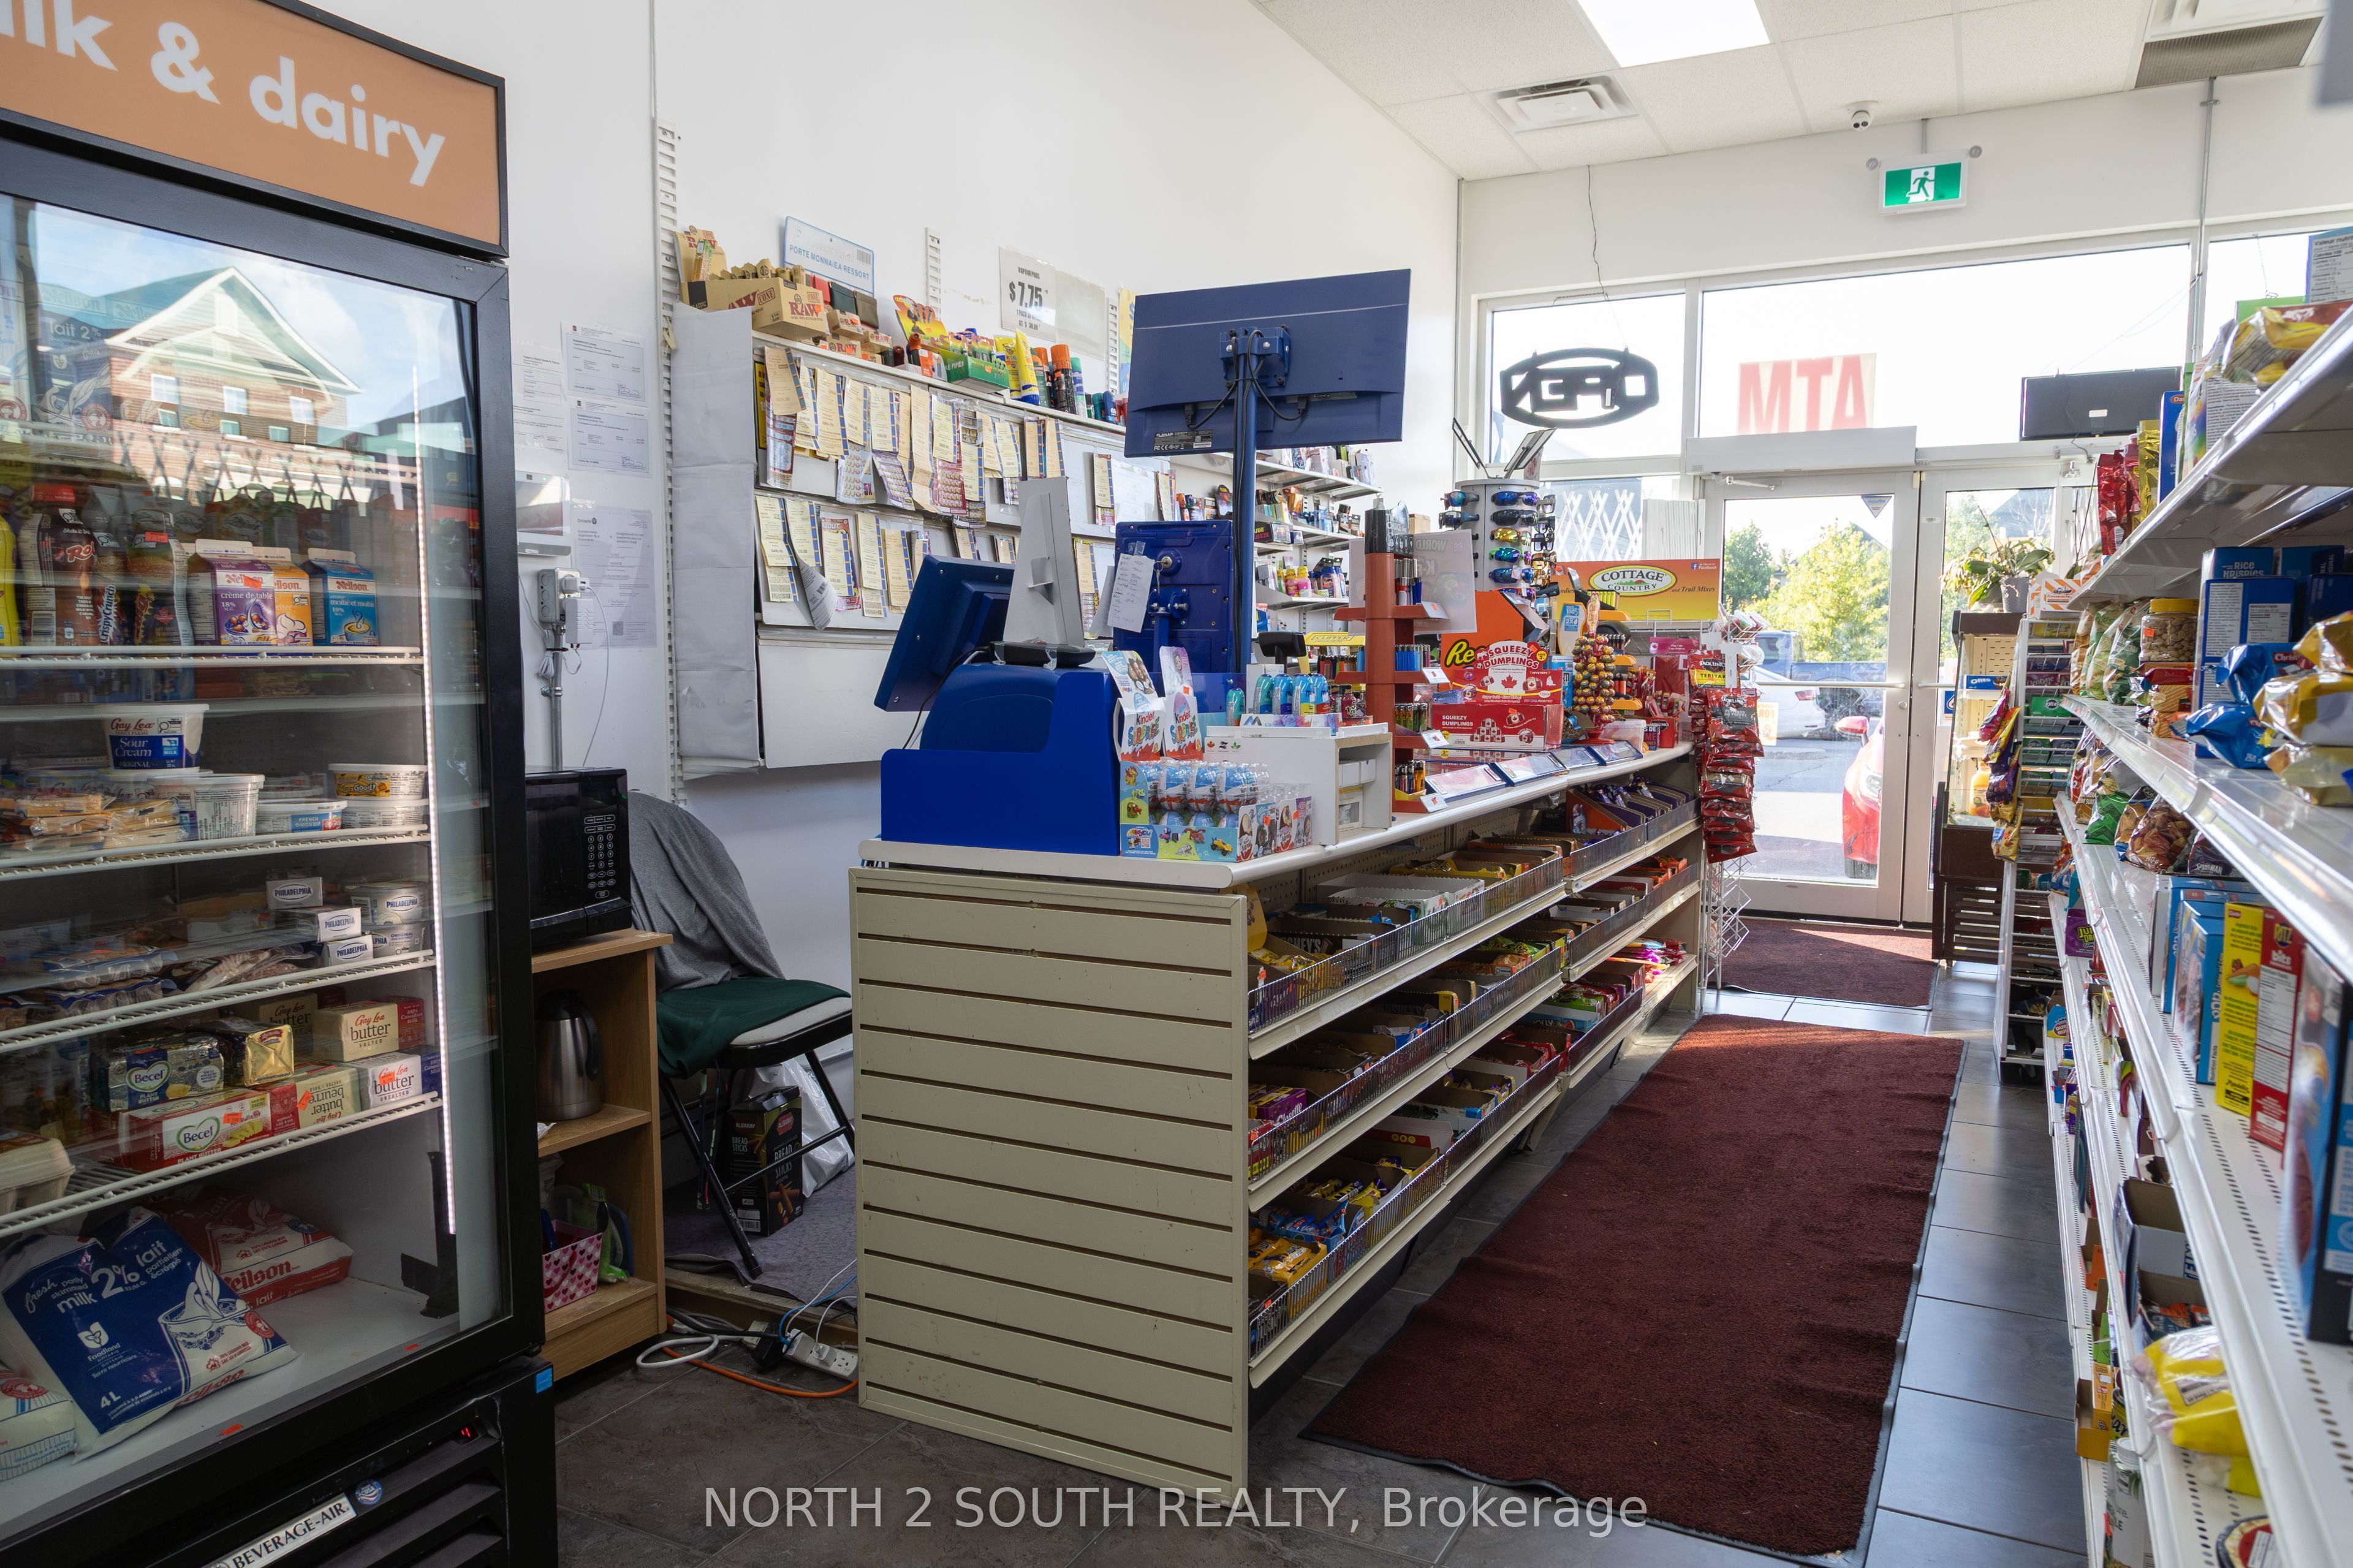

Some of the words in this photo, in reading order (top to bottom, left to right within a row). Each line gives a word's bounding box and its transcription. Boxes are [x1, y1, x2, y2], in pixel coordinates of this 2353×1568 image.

[150, 21, 222, 105] &
[248, 55, 446, 187] dairy
[686, 235, 718, 249] RW
[789, 244, 809, 259] PORTE
[843, 265, 870, 280] RESSORT
[728, 290, 759, 309] AW
[757, 287, 776, 305] CONE
[807, 292, 820, 302] CONE
[789, 301, 820, 318] RAW
[875, 334, 890, 343] RAW
[2234, 561, 2255, 570] Rice
[1601, 570, 1664, 583] COTTAGE
[336, 580, 369, 592] Neilson
[1607, 583, 1658, 592] COUNTRY
[1487, 645, 1534, 658] SQUEEZY
[1483, 656, 1540, 670] DUMPLINGS
[2027, 675, 2054, 687] Dentyne
[110, 717, 131, 732] Gay
[134, 718, 155, 730] Lea
[119, 738, 148, 749] Sour
[115, 747, 152, 757] Cream
[354, 784, 377, 793] Good!
[275, 887, 312, 897] PHILADELPHIA
[386, 897, 418, 909] PHILADELPHIA
[325, 917, 355, 929] PHILADELPHIA
[2275, 924, 2293, 944] RITZ
[336, 943, 368, 958] PHILADELPHIA
[2272, 950, 2292, 965] bits
[355, 1014, 371, 1026] Gay
[373, 1012, 386, 1023] Lea
[350, 1022, 391, 1042] butter
[359, 1039, 383, 1048] SALTED
[134, 1069, 165, 1084] Becel
[396, 1064, 408, 1076] Lea
[373, 1074, 414, 1094] butter
[308, 1086, 344, 1104] beurre
[380, 1090, 409, 1102] UNSALTED
[311, 1099, 343, 1115] butter
[183, 1126, 215, 1143] Becel
[177, 1155, 198, 1164] PLANT
[199, 1148, 221, 1159] BUTTER
[732, 1144, 748, 1153] STICKS
[135, 1240, 167, 1267] lait
[91, 1264, 140, 1300] 2%
[25, 1279, 58, 1314] fresh
[51, 1282, 89, 1300] skimmed
[56, 1291, 98, 1314] milk
[256, 1291, 274, 1307] lait
[87, 1342, 121, 1362] Foodland
[99, 1395, 112, 1408] 4
[110, 1390, 121, 1401] L
[232, 1501, 347, 1568] BEVERAGE-AIR
